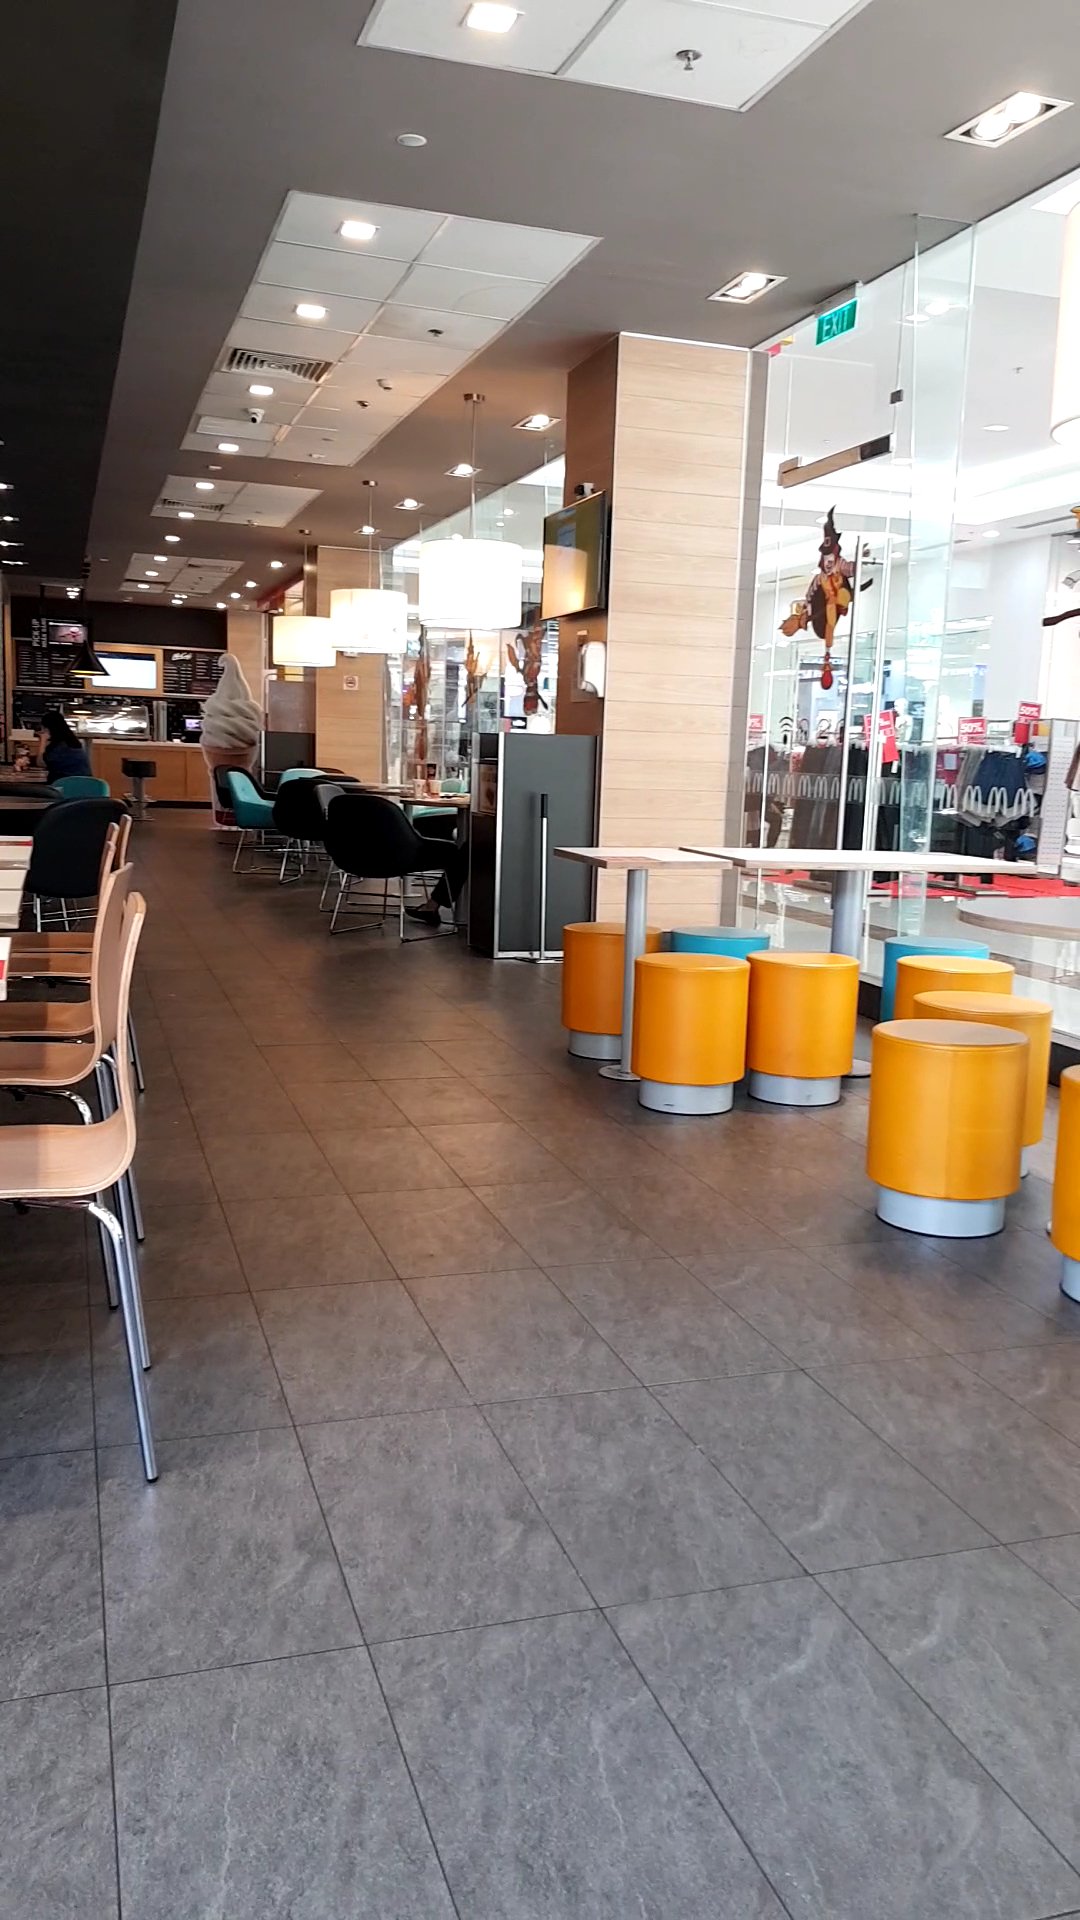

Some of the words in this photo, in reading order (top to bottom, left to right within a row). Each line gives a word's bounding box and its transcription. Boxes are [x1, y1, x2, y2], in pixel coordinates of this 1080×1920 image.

[822, 305, 852, 341] EXIT
[31, 618, 41, 647] PICK-UP
[1019, 705, 1040, 717] 50%
[960, 721, 985, 733] 50%
